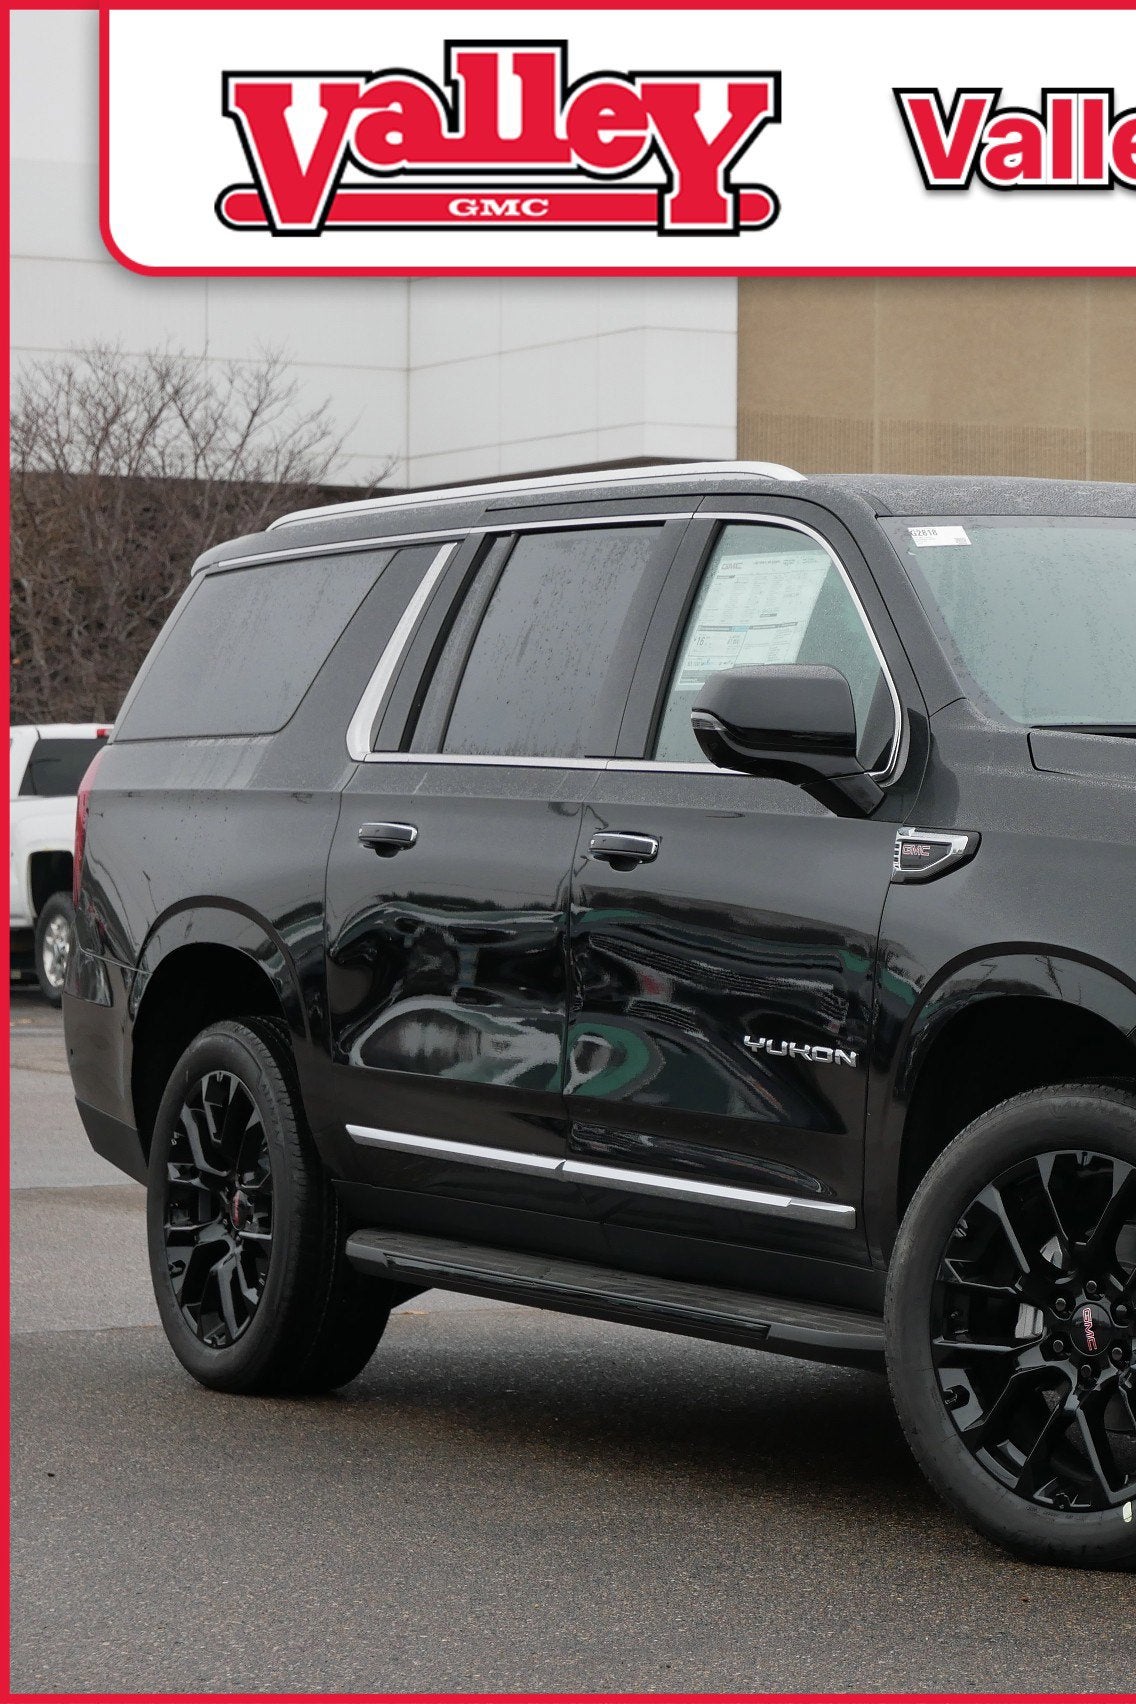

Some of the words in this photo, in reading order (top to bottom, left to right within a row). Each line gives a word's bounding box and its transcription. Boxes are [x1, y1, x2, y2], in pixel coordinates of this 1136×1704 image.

[902, 844, 931, 857] GMC
[743, 1034, 859, 1068] YUKON
[1082, 1307, 1098, 1352] GMC
